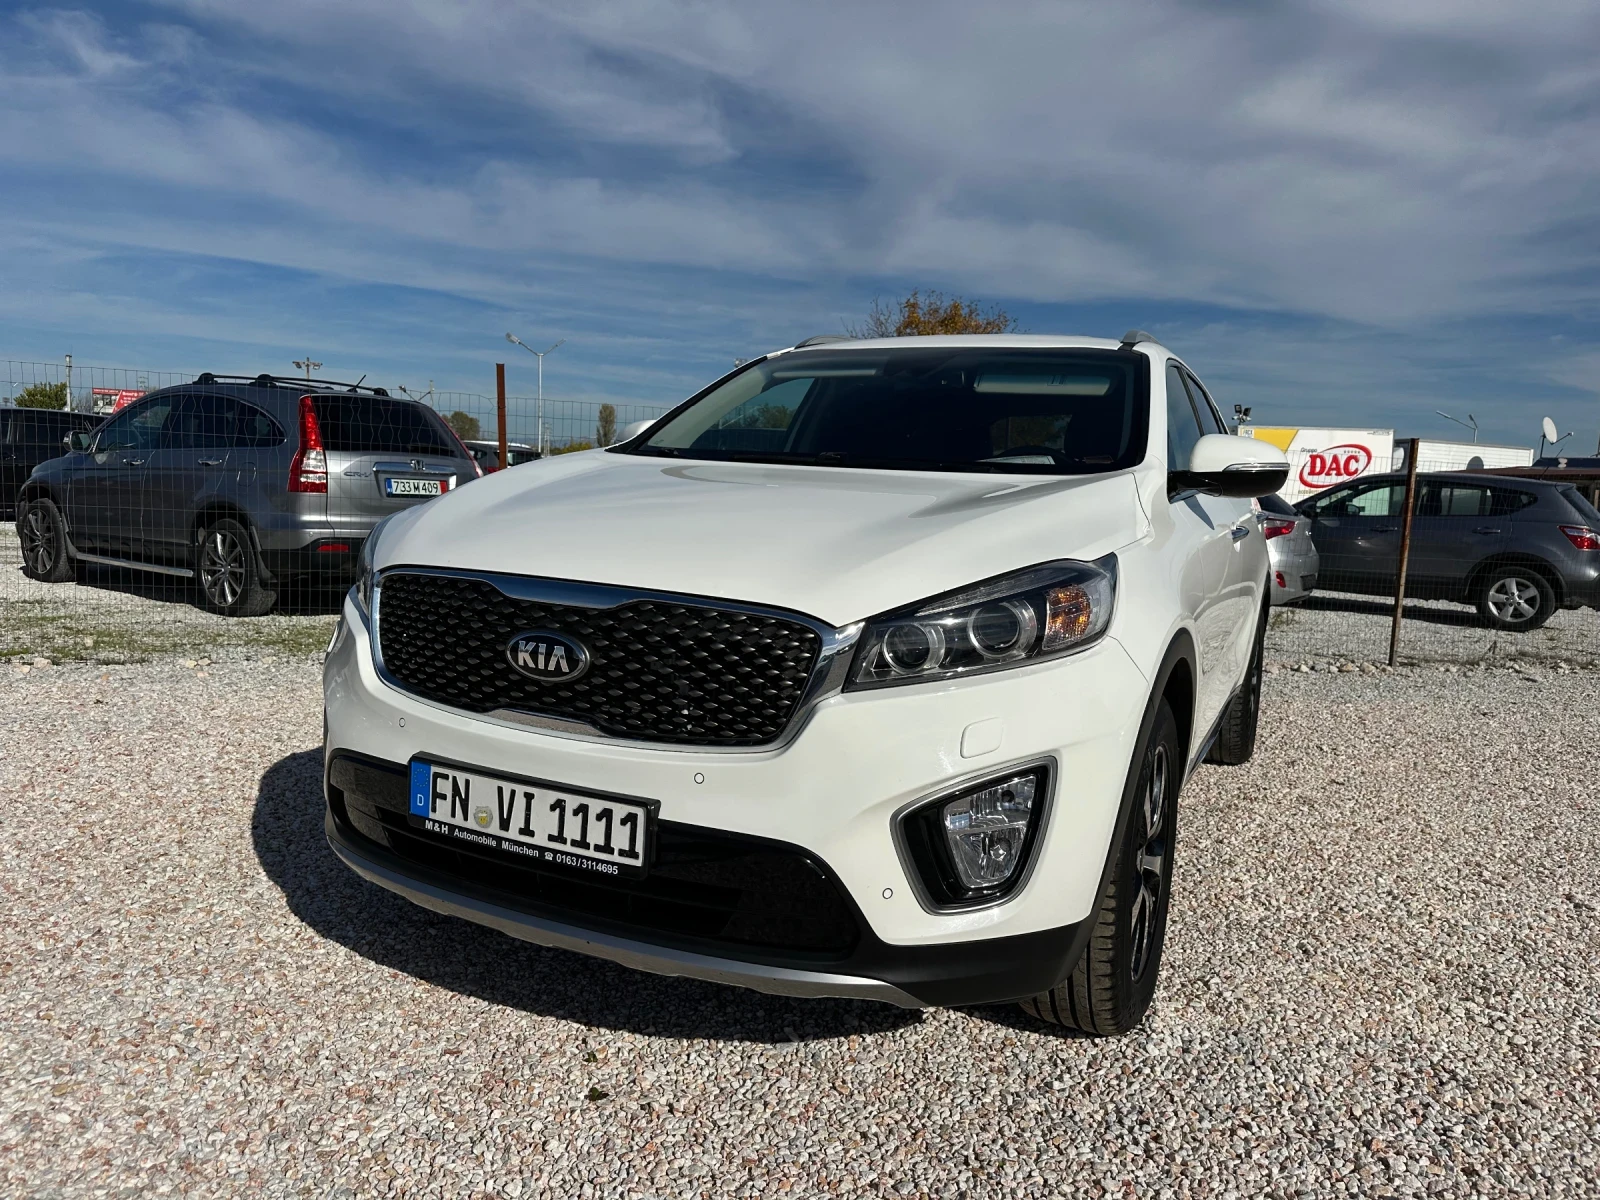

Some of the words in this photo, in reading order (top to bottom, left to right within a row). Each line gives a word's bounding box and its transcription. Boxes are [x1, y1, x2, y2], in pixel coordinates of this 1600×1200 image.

[1308, 454, 1360, 477] DAC
[393, 481, 411, 493] 733
[413, 482, 420, 493] M
[422, 482, 439, 494] 409
[518, 640, 570, 673] KIA
[416, 794, 425, 807] D
[430, 771, 471, 822] FN
[497, 785, 536, 838] VI
[547, 798, 640, 860] 1111
[453, 828, 497, 847] Automobile
[501, 839, 539, 858] München
